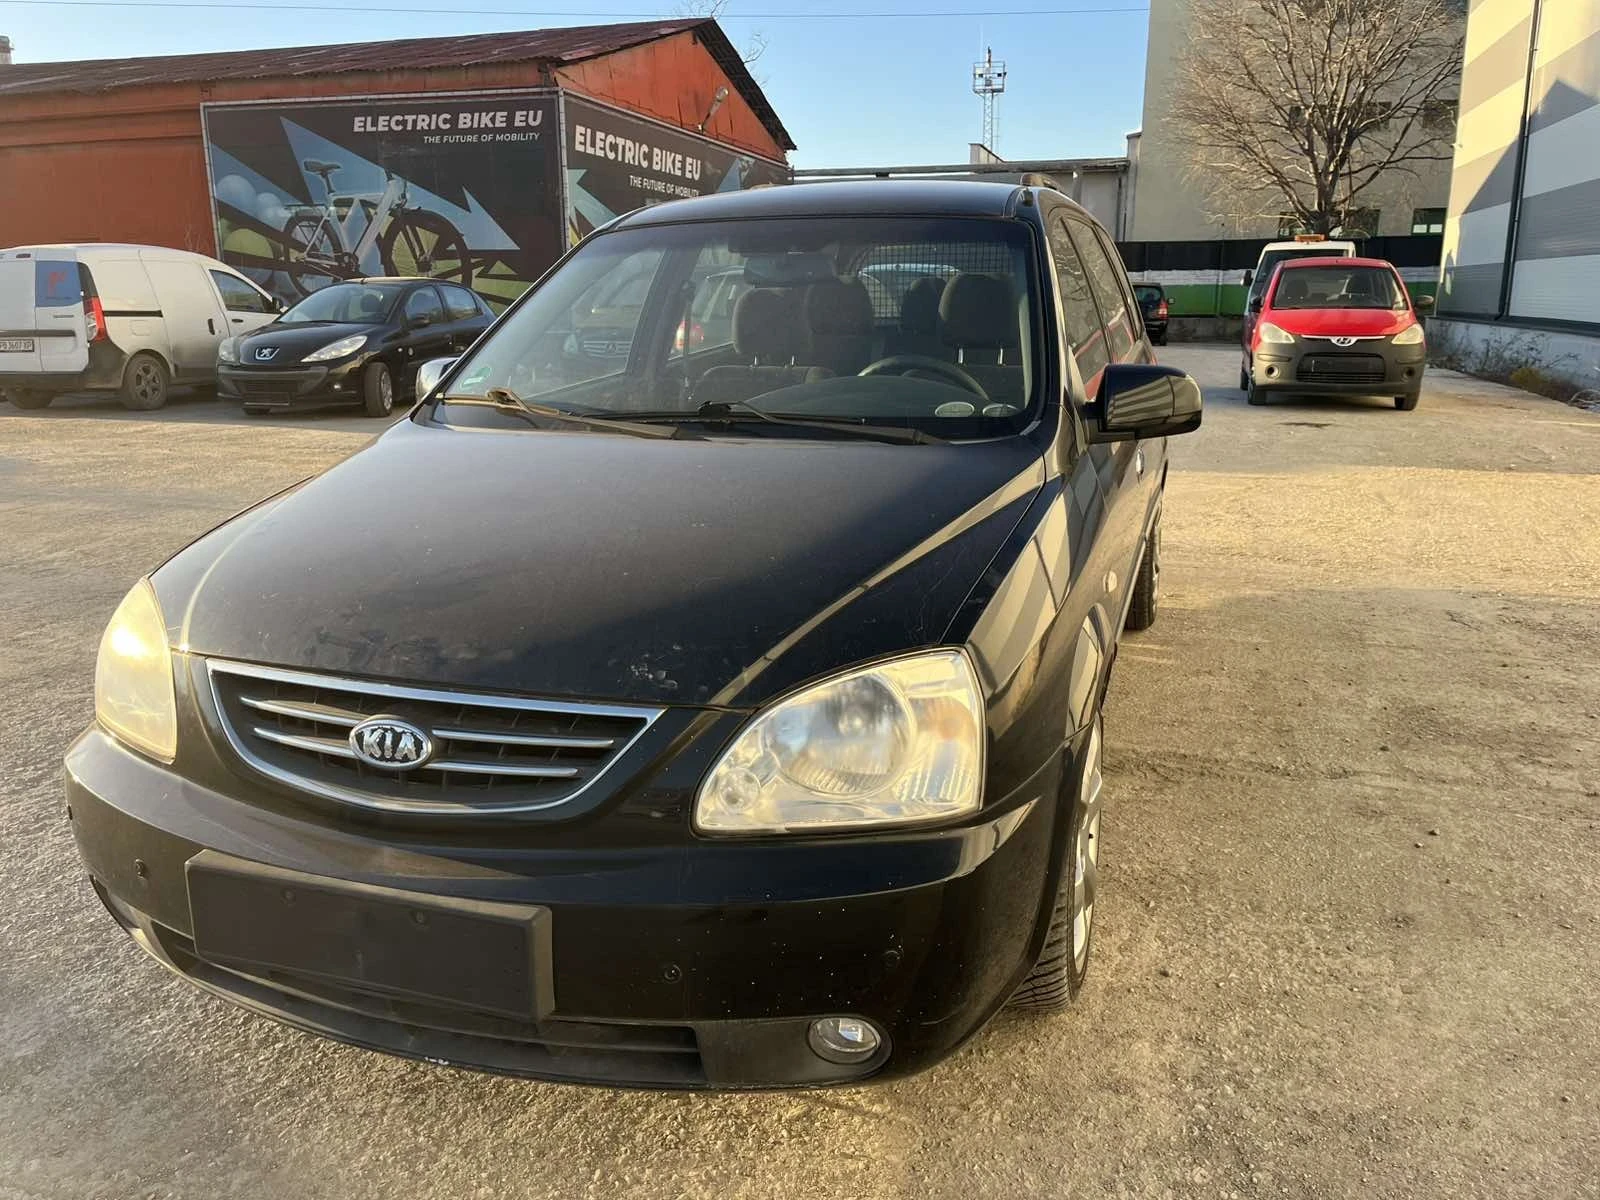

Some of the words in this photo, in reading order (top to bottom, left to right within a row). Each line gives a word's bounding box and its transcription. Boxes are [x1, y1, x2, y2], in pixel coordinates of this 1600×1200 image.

[353, 114, 451, 132] ELECTRIC
[458, 111, 508, 129] BIKE
[514, 110, 543, 127] EU
[423, 135, 441, 144] THE
[443, 134, 478, 143] FUTURE
[481, 133, 493, 142] OF
[496, 132, 540, 142] MOBILITY
[575, 125, 649, 168] ELECTRIC
[652, 147, 683, 176] BIKE
[685, 157, 701, 181] EU
[629, 174, 642, 188] THE
[643, 178, 666, 193] FUTURE
[666, 183, 675, 194] OF
[675, 185, 700, 198] MOBILITY
[362, 728, 417, 760] KIA
